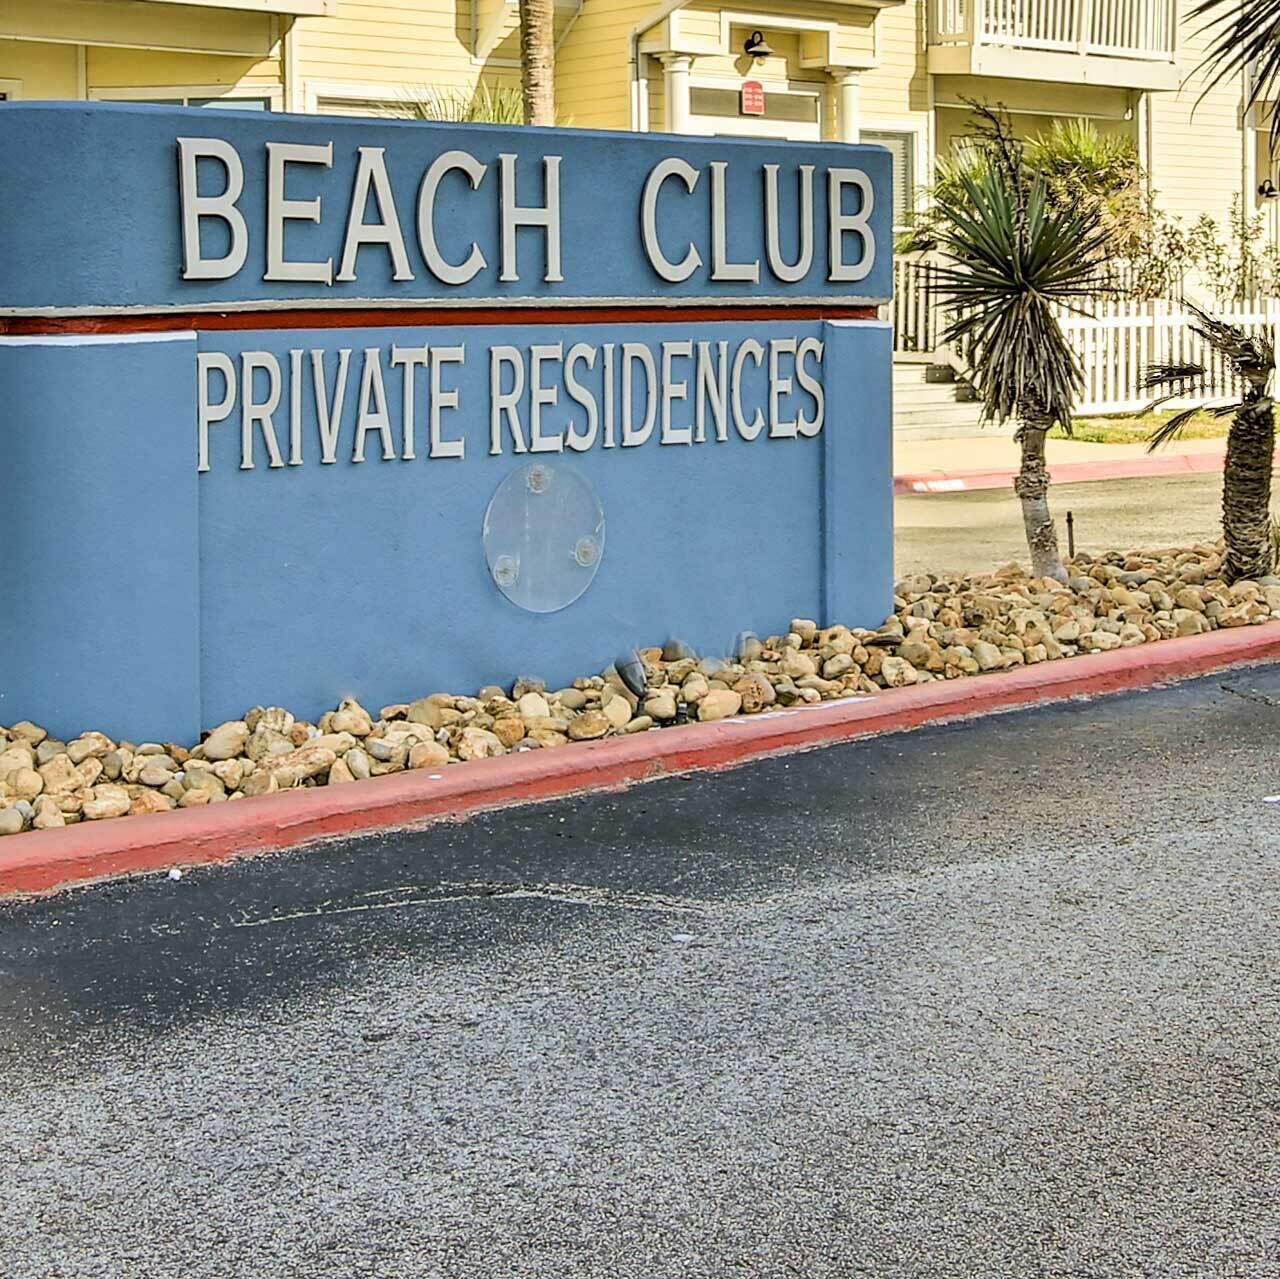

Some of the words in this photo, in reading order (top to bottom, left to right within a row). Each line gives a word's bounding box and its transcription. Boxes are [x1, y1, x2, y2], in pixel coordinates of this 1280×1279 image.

[176, 137, 564, 287] BEACH
[641, 157, 876, 284] CLUB
[197, 342, 465, 471] PRIVATE
[488, 336, 825, 455] RESIDENCES
